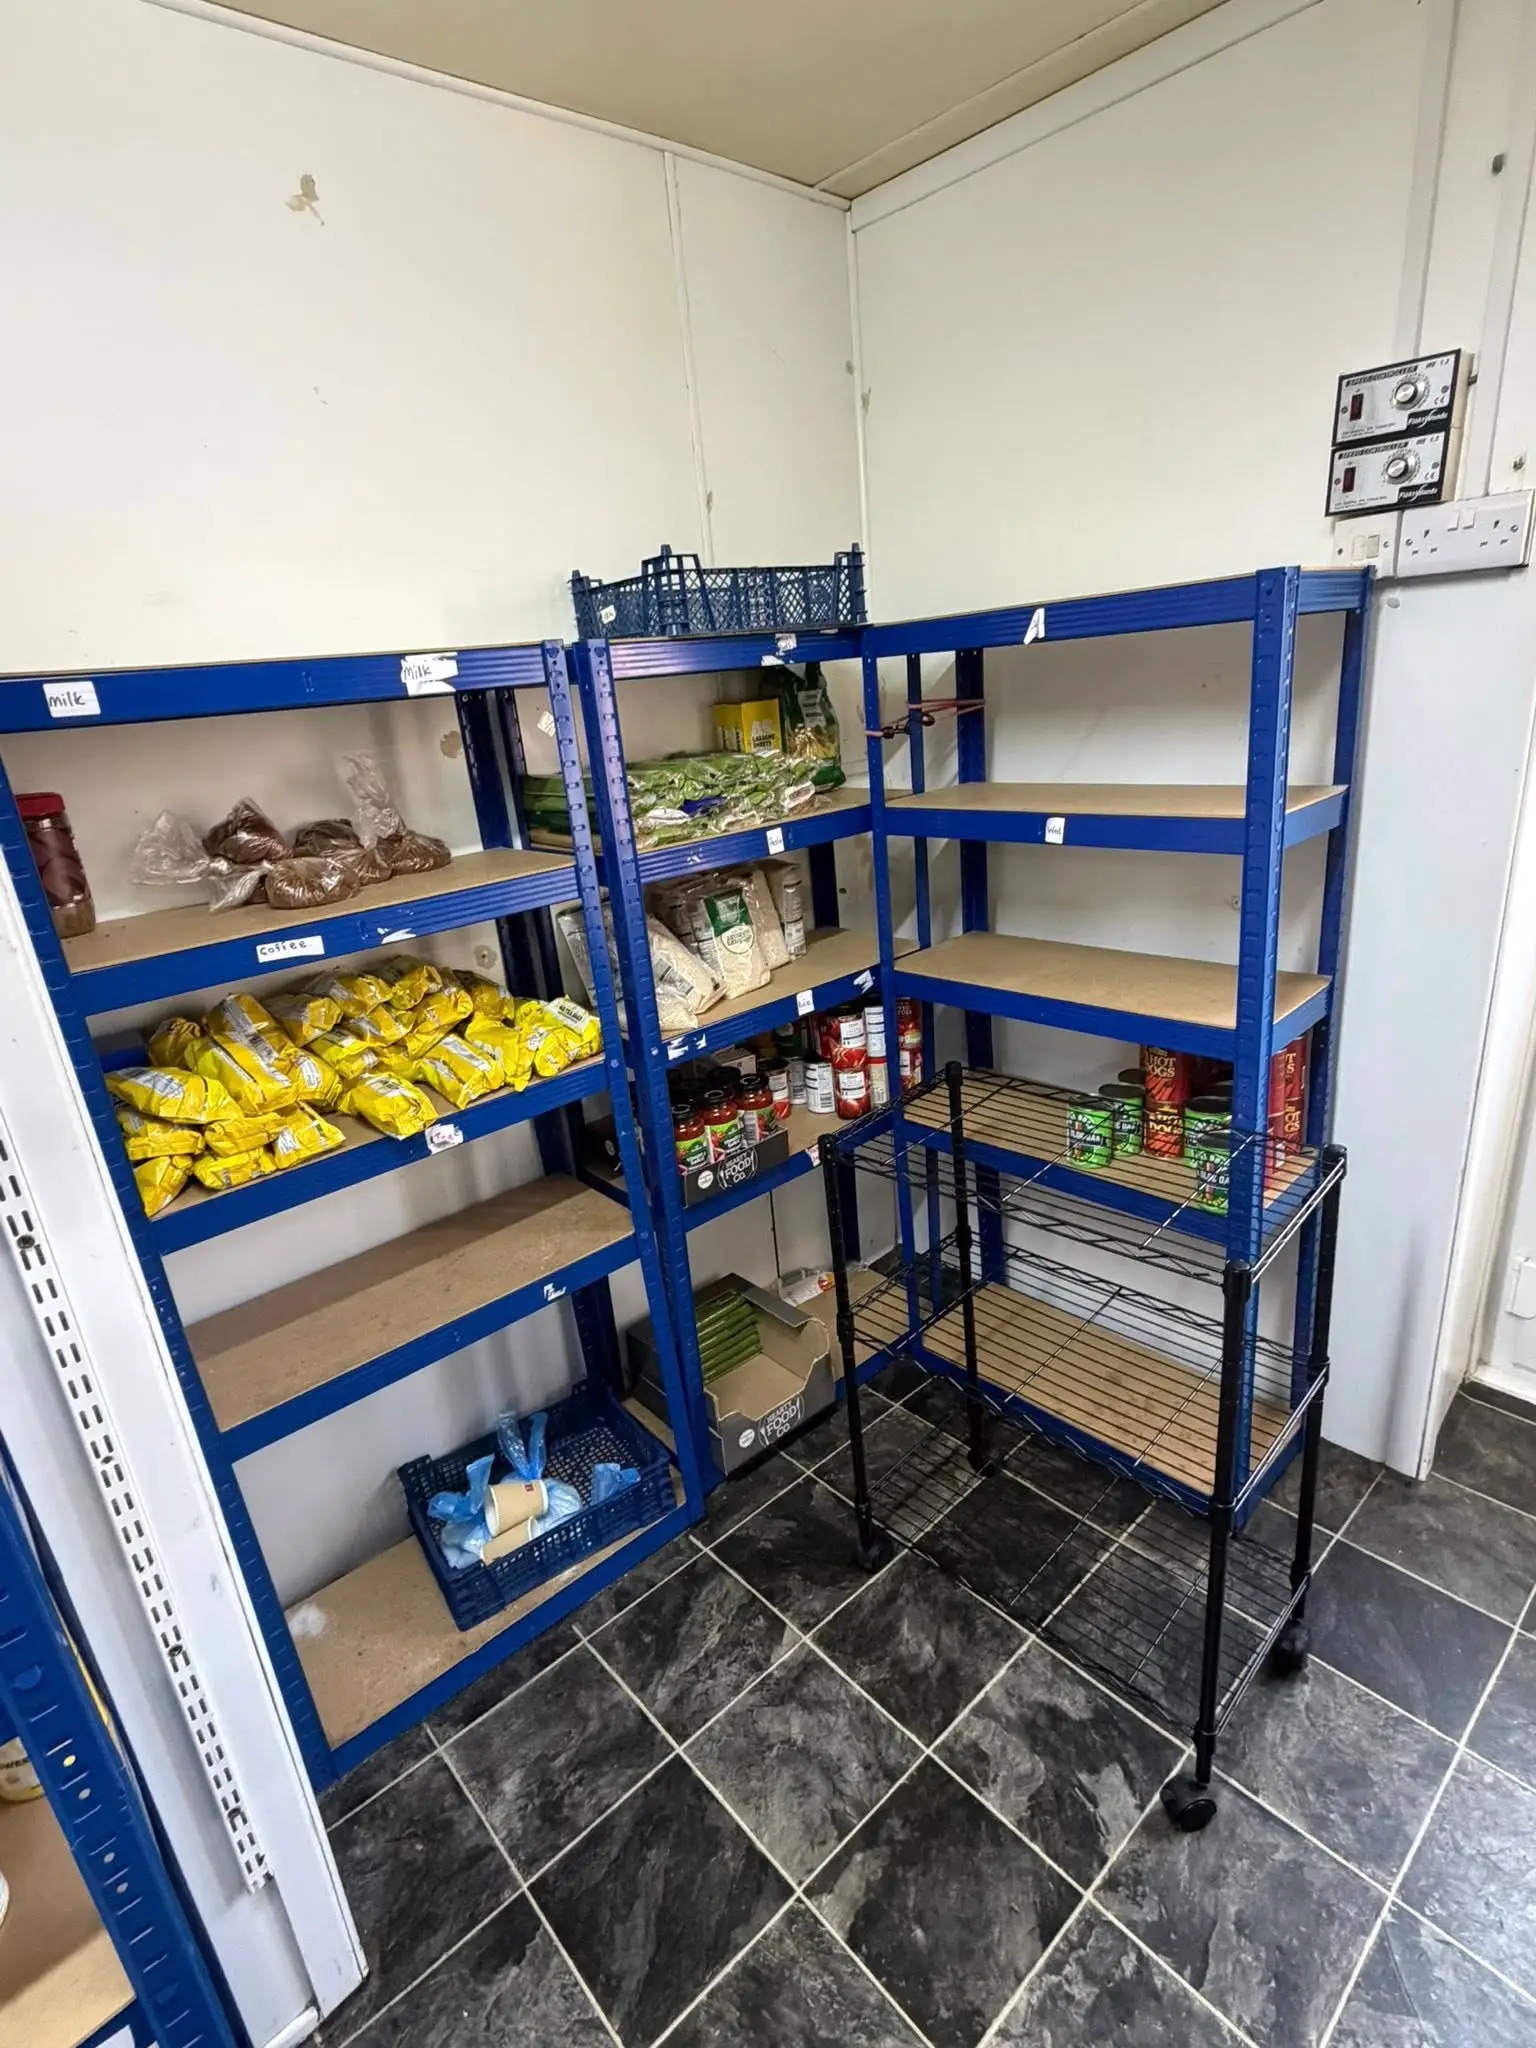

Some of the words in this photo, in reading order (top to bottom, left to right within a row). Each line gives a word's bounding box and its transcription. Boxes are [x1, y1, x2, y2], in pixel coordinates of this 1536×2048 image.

[48, 691, 87, 708] milk
[1150, 1056, 1177, 1067] HOT
[724, 1157, 752, 1180] FOOD
[766, 1406, 797, 1436] FOOD
